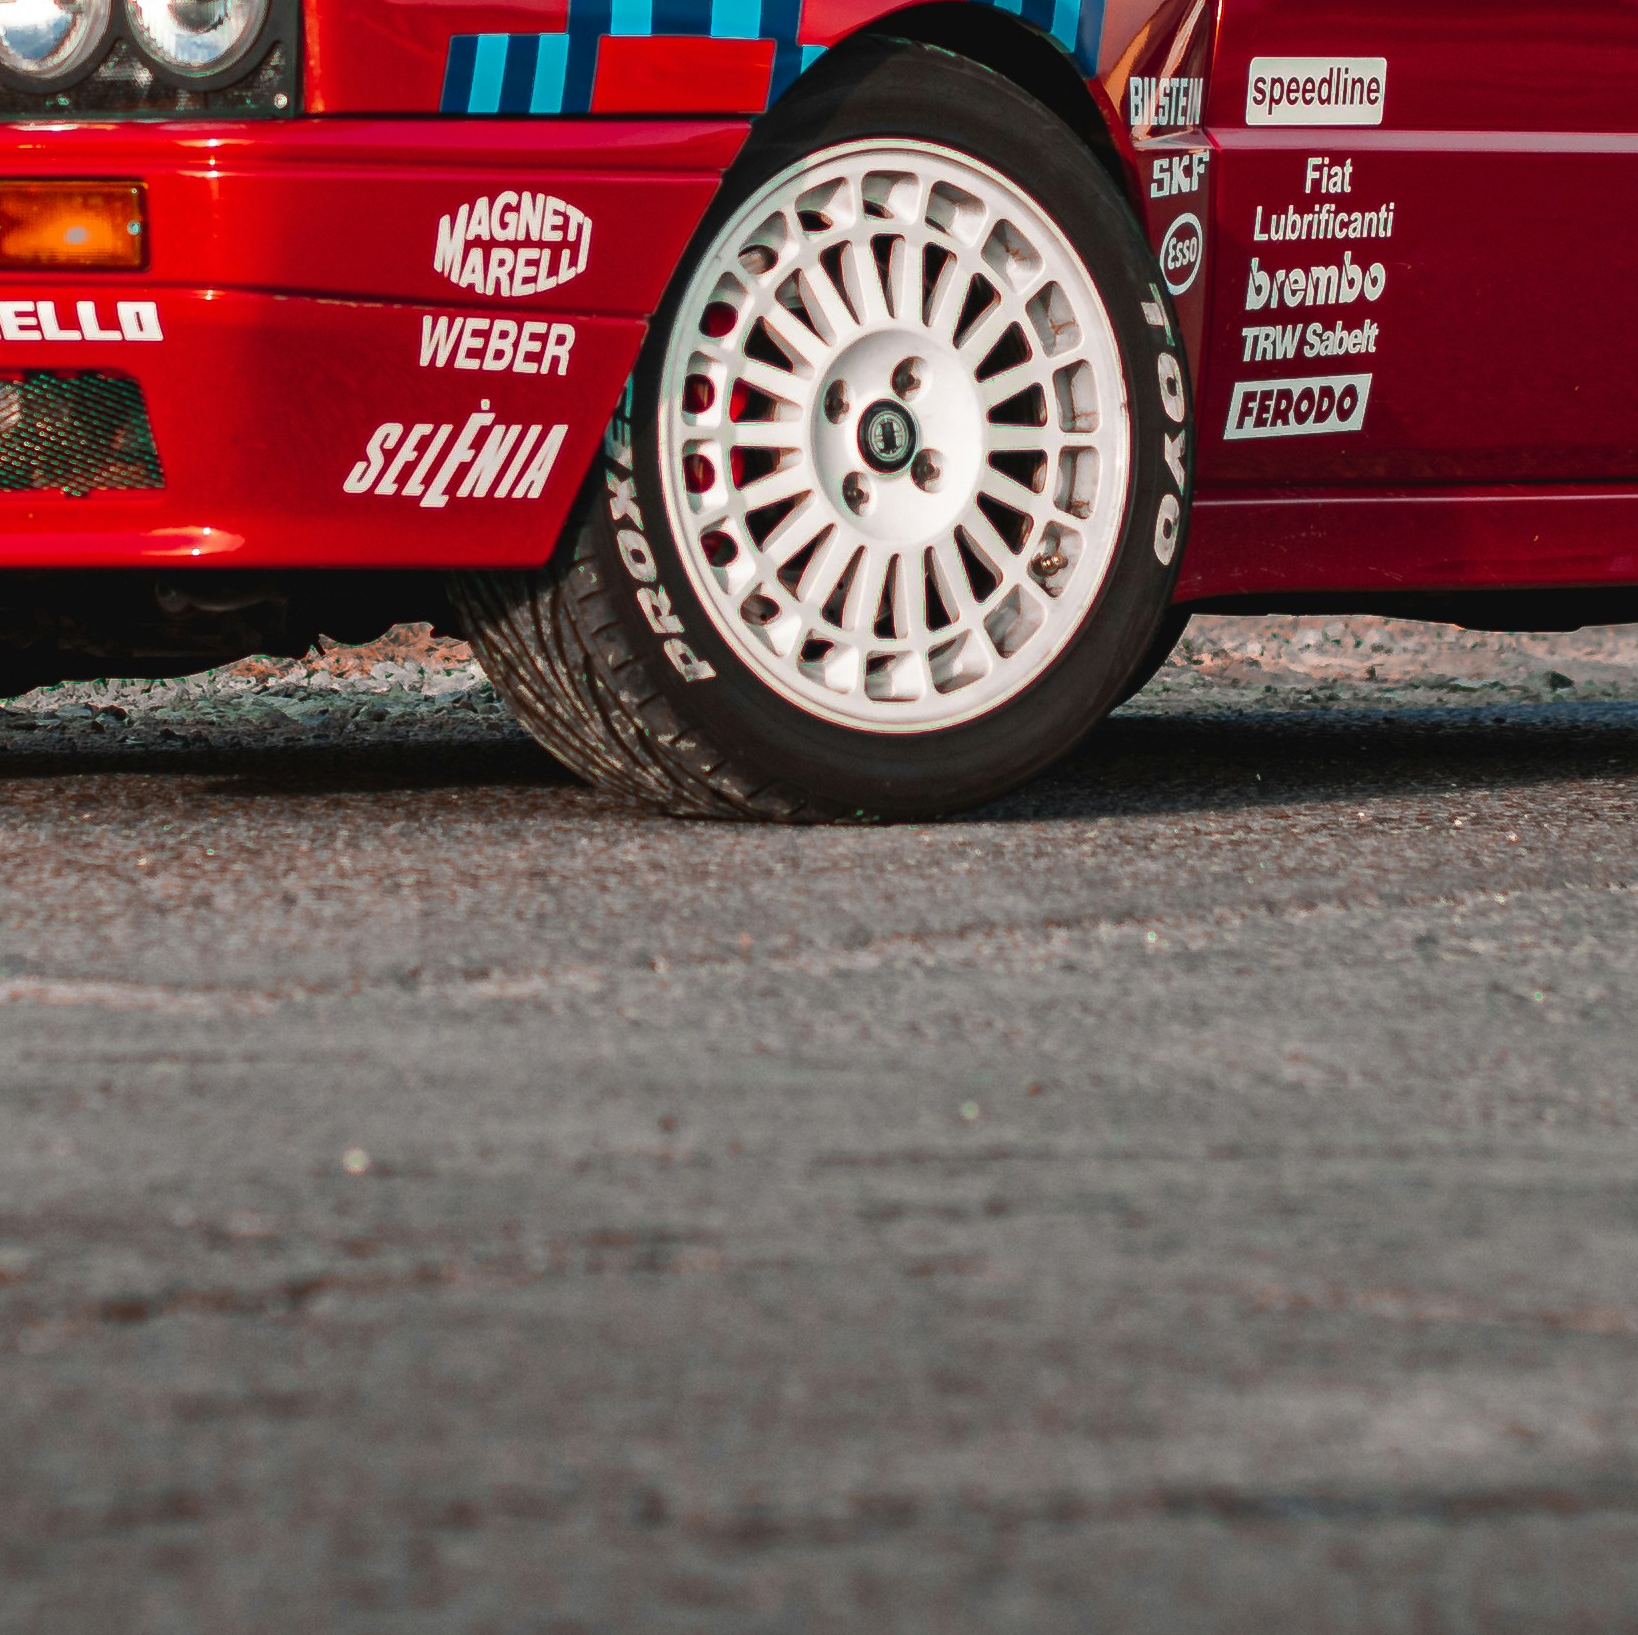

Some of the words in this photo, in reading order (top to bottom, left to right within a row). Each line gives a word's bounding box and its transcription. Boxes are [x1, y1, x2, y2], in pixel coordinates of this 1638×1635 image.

[1129, 77, 1204, 126] BILSTEIN
[1252, 67, 1381, 116] speedline
[1150, 149, 1210, 199] SKF
[1305, 157, 1353, 194] Fiat
[1253, 202, 1395, 242] Lubrificanti
[1245, 250, 1386, 310] brembo
[419, 315, 576, 376] WEBER
[1242, 323, 1303, 363] TRW
[1303, 319, 1380, 358] Sabelt
[1141, 283, 1186, 567] TOYO
[1235, 383, 1359, 430] FERODO
